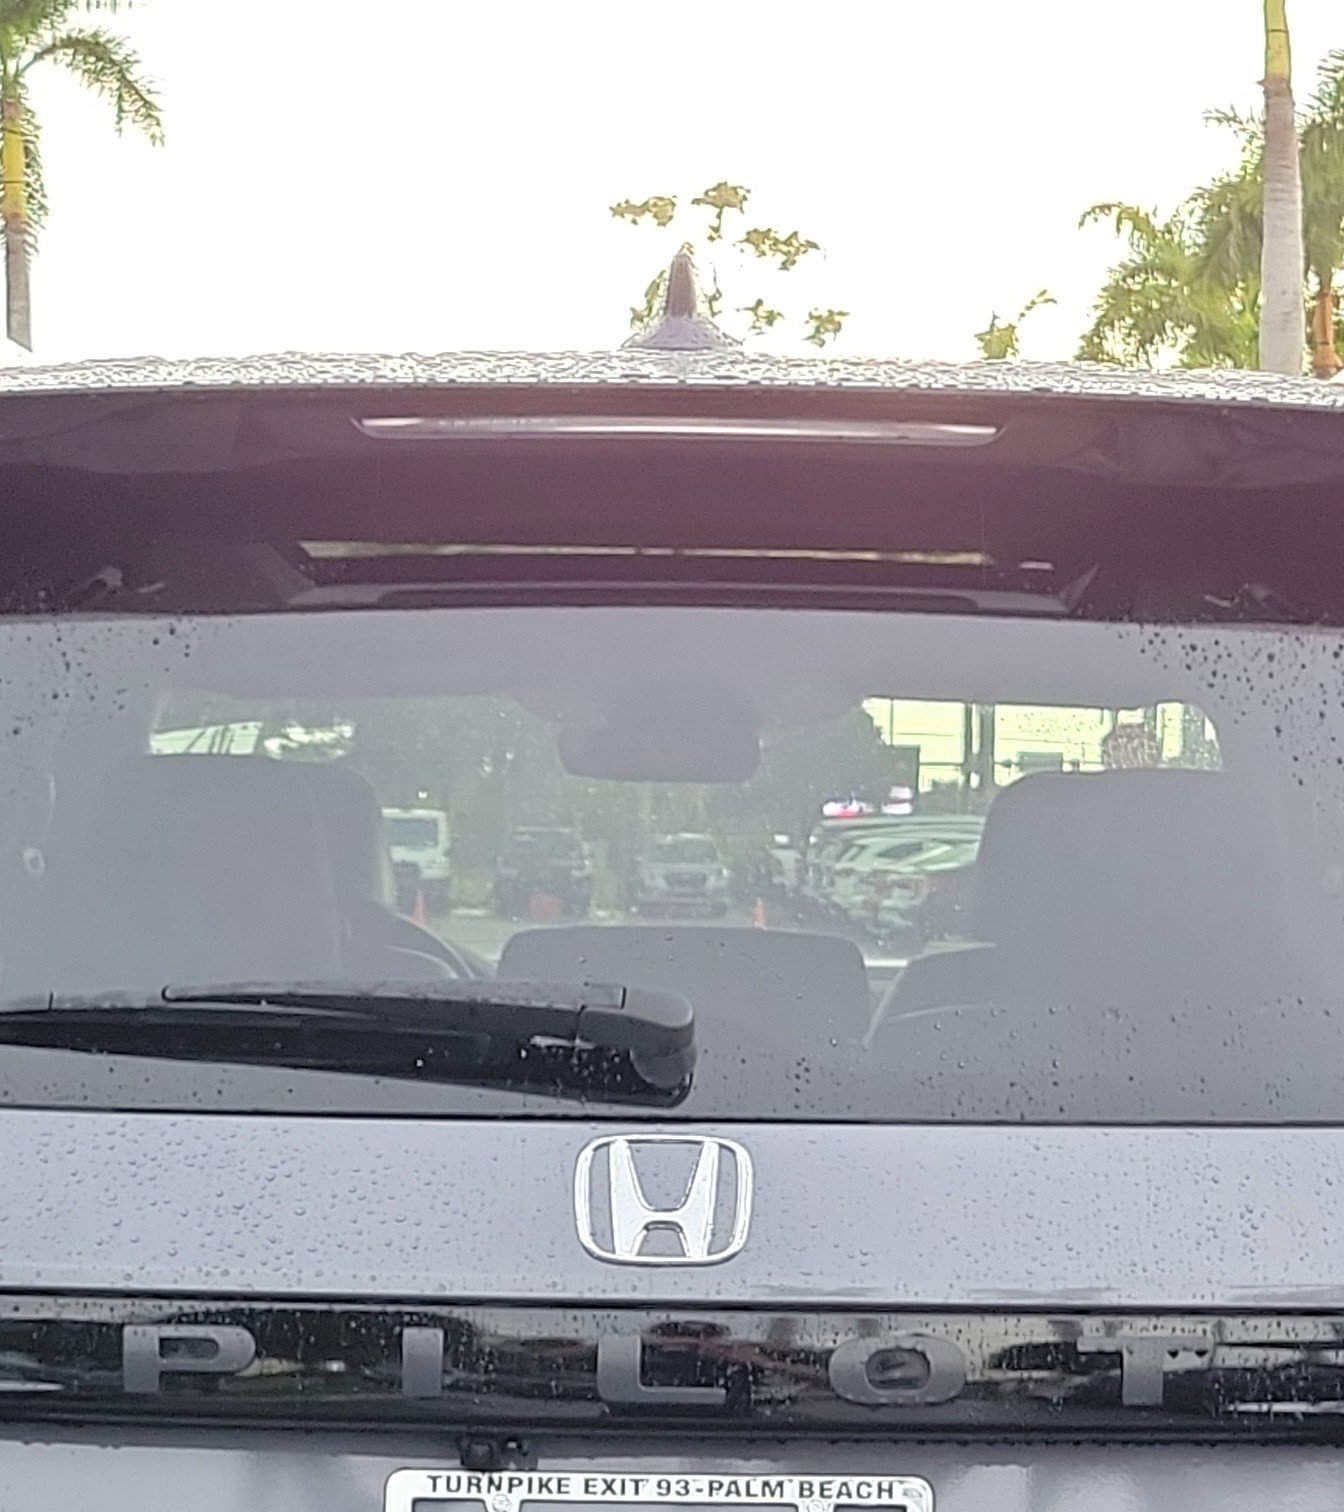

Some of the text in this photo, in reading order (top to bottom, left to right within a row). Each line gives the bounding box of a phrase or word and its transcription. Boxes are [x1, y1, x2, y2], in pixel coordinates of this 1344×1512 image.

[122, 1323, 1216, 1406] PILOT
[426, 1474, 571, 1495] TURNPIKE
[583, 1477, 644, 1496] EXIT
[798, 1480, 894, 1500] BEACH
